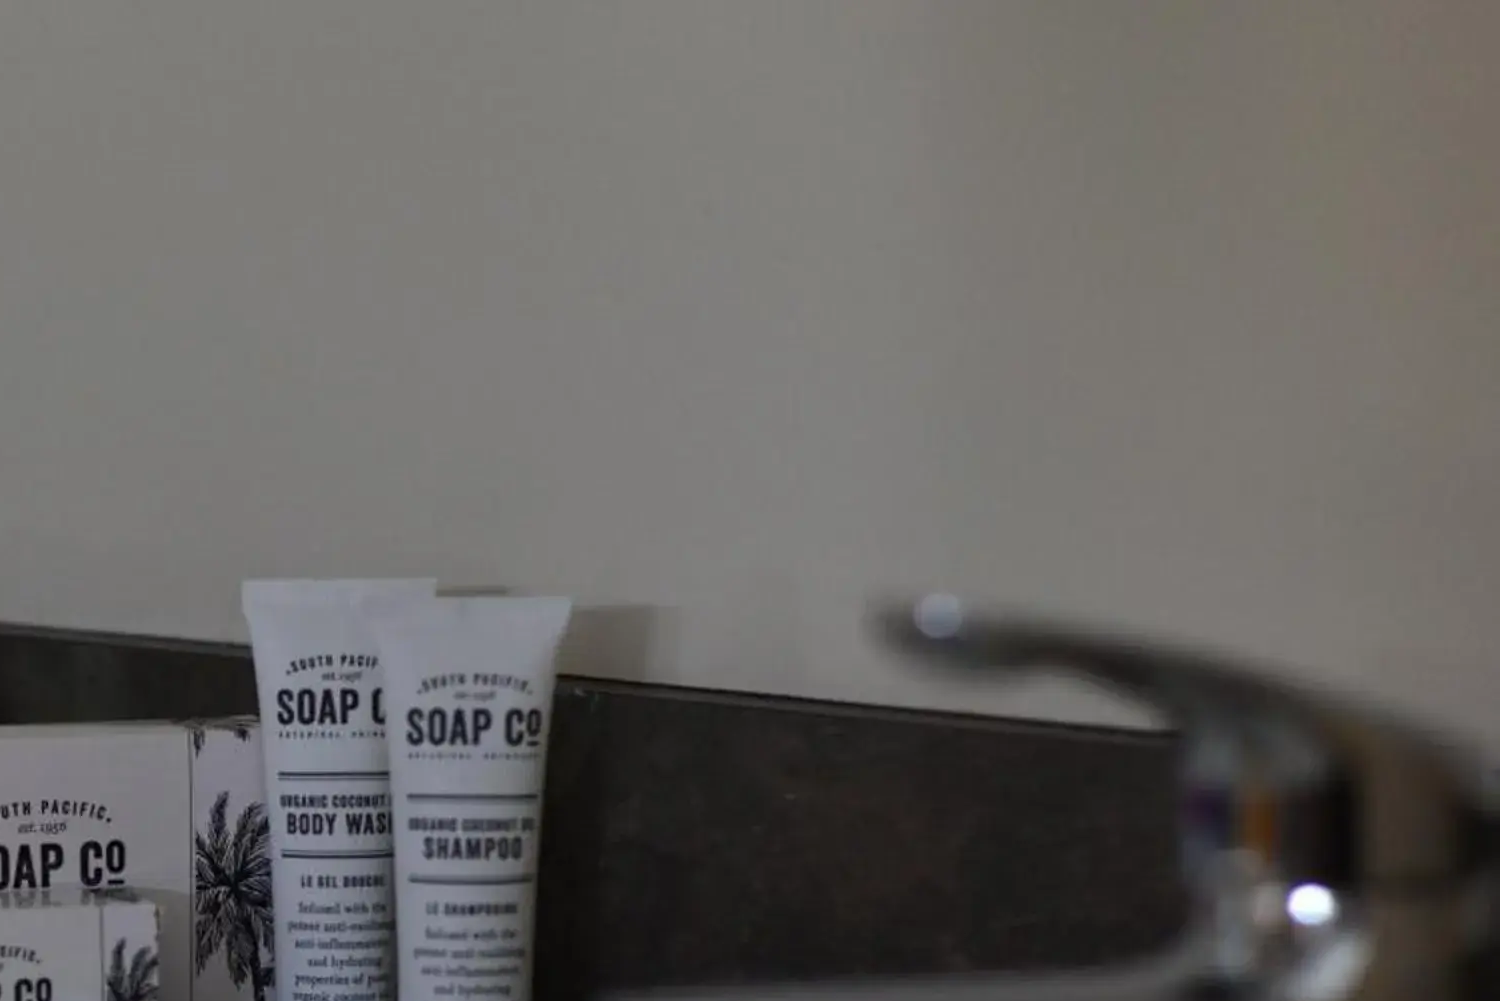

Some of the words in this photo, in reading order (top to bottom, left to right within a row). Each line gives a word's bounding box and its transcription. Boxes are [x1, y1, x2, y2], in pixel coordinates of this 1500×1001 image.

[340, 654, 380, 670] PACIF
[276, 687, 360, 726] SOAP
[406, 707, 493, 747] SOAP
[41, 799, 106, 823] PACIFIC
[280, 794, 329, 808] ORGANIC
[332, 794, 386, 808] COCONUT
[286, 812, 338, 836] BODY
[422, 836, 523, 860] SHAMPOO
